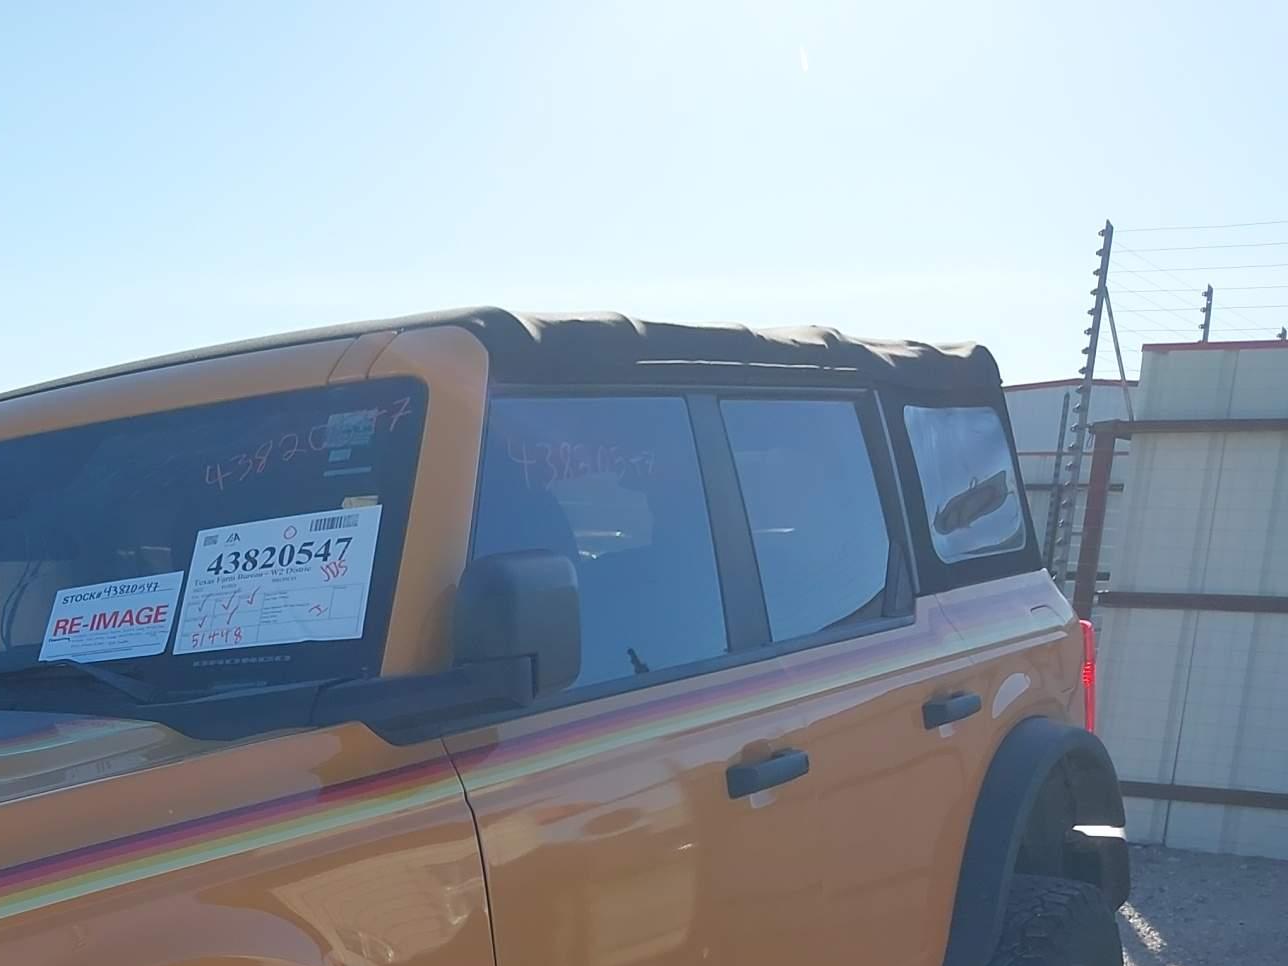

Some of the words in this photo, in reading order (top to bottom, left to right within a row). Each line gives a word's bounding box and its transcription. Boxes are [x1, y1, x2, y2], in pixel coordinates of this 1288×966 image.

[207, 536, 353, 576] 43820547
[62, 591, 102, 605] STOCK#
[53, 604, 169, 637] RE-IMAGE
